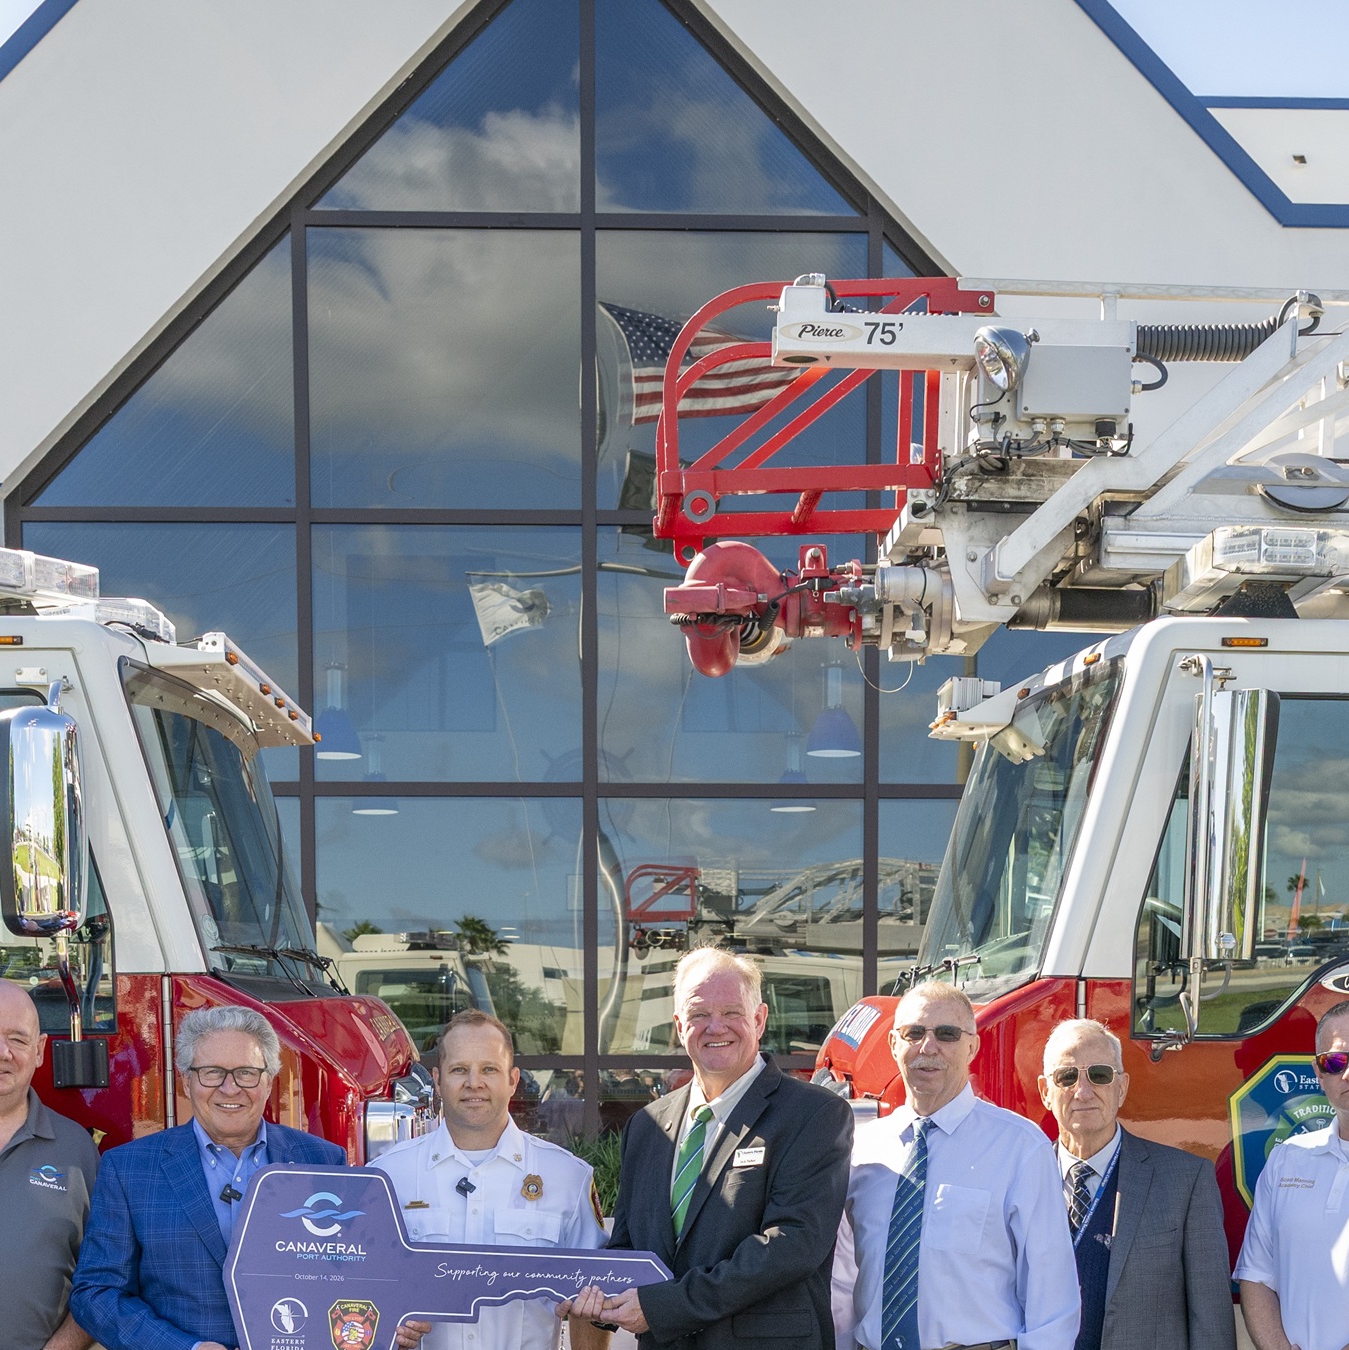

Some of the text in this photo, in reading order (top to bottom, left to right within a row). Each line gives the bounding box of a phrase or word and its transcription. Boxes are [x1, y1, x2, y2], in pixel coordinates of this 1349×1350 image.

[798, 324, 844, 338] Pierce
[29, 1179, 67, 1191] CANAVERAL
[275, 1240, 366, 1255] CANAVERAL
[321, 1254, 366, 1262] AUTHORITY
[434, 1263, 499, 1285] Supporting
[525, 1268, 587, 1288] community
[588, 1270, 635, 1286] partners
[340, 1303, 368, 1311] CANAVERAL
